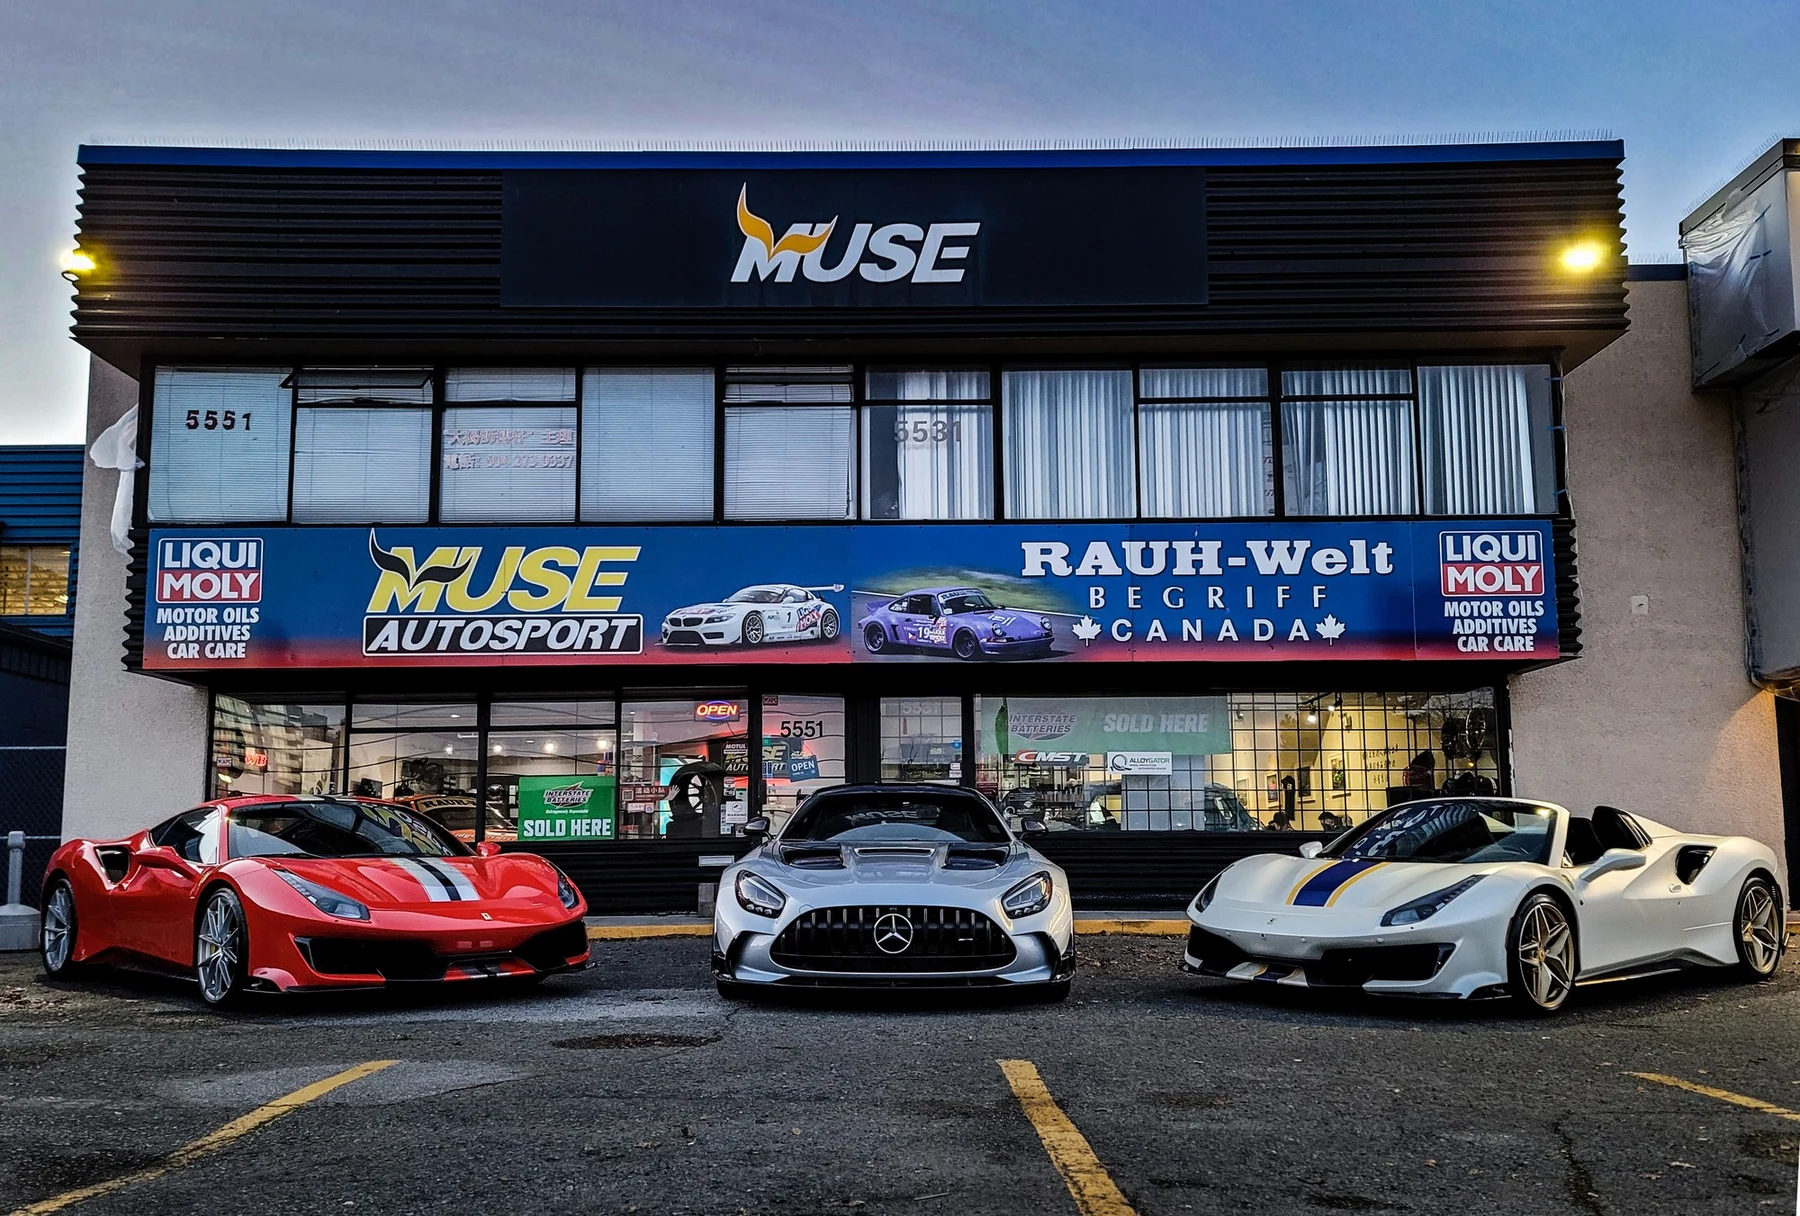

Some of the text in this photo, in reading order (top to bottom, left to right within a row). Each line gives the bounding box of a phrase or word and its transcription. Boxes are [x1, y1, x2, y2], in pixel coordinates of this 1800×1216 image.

[730, 200, 980, 283] MUSE
[185, 410, 251, 430] 5551
[894, 420, 961, 443] 5531
[164, 541, 257, 570] LIQUI
[1446, 534, 1537, 563] LIQUI
[1021, 539, 1393, 576] RAUH-Welt
[365, 536, 642, 613] MUSE
[1447, 565, 1540, 593] MOLY
[163, 572, 259, 600] MOLY
[1089, 585, 1326, 609] BEGRIFF
[156, 608, 259, 624] MOTOR OILS
[786, 612, 792, 623] 1
[1444, 601, 1544, 617] MOTOR OILS
[163, 625, 251, 641] ADDITIVES
[366, 618, 639, 651] AUTOSPORT
[918, 626, 930, 638] 19
[1111, 618, 1310, 642] CANADA
[1452, 618, 1537, 634] ADDITIVES
[167, 643, 246, 659] CAR CARE
[1457, 636, 1534, 652] CAR CARE
[697, 705, 737, 716] OPEN
[1009, 715, 1076, 723] INTERSTATE
[781, 721, 823, 737] 5551
[1011, 724, 1071, 733] BATTERIES
[1103, 713, 1209, 733] SOLD HERE
[1018, 751, 1087, 762] CMST
[791, 760, 815, 772] OPEN
[523, 819, 612, 837] SOLD HERE
